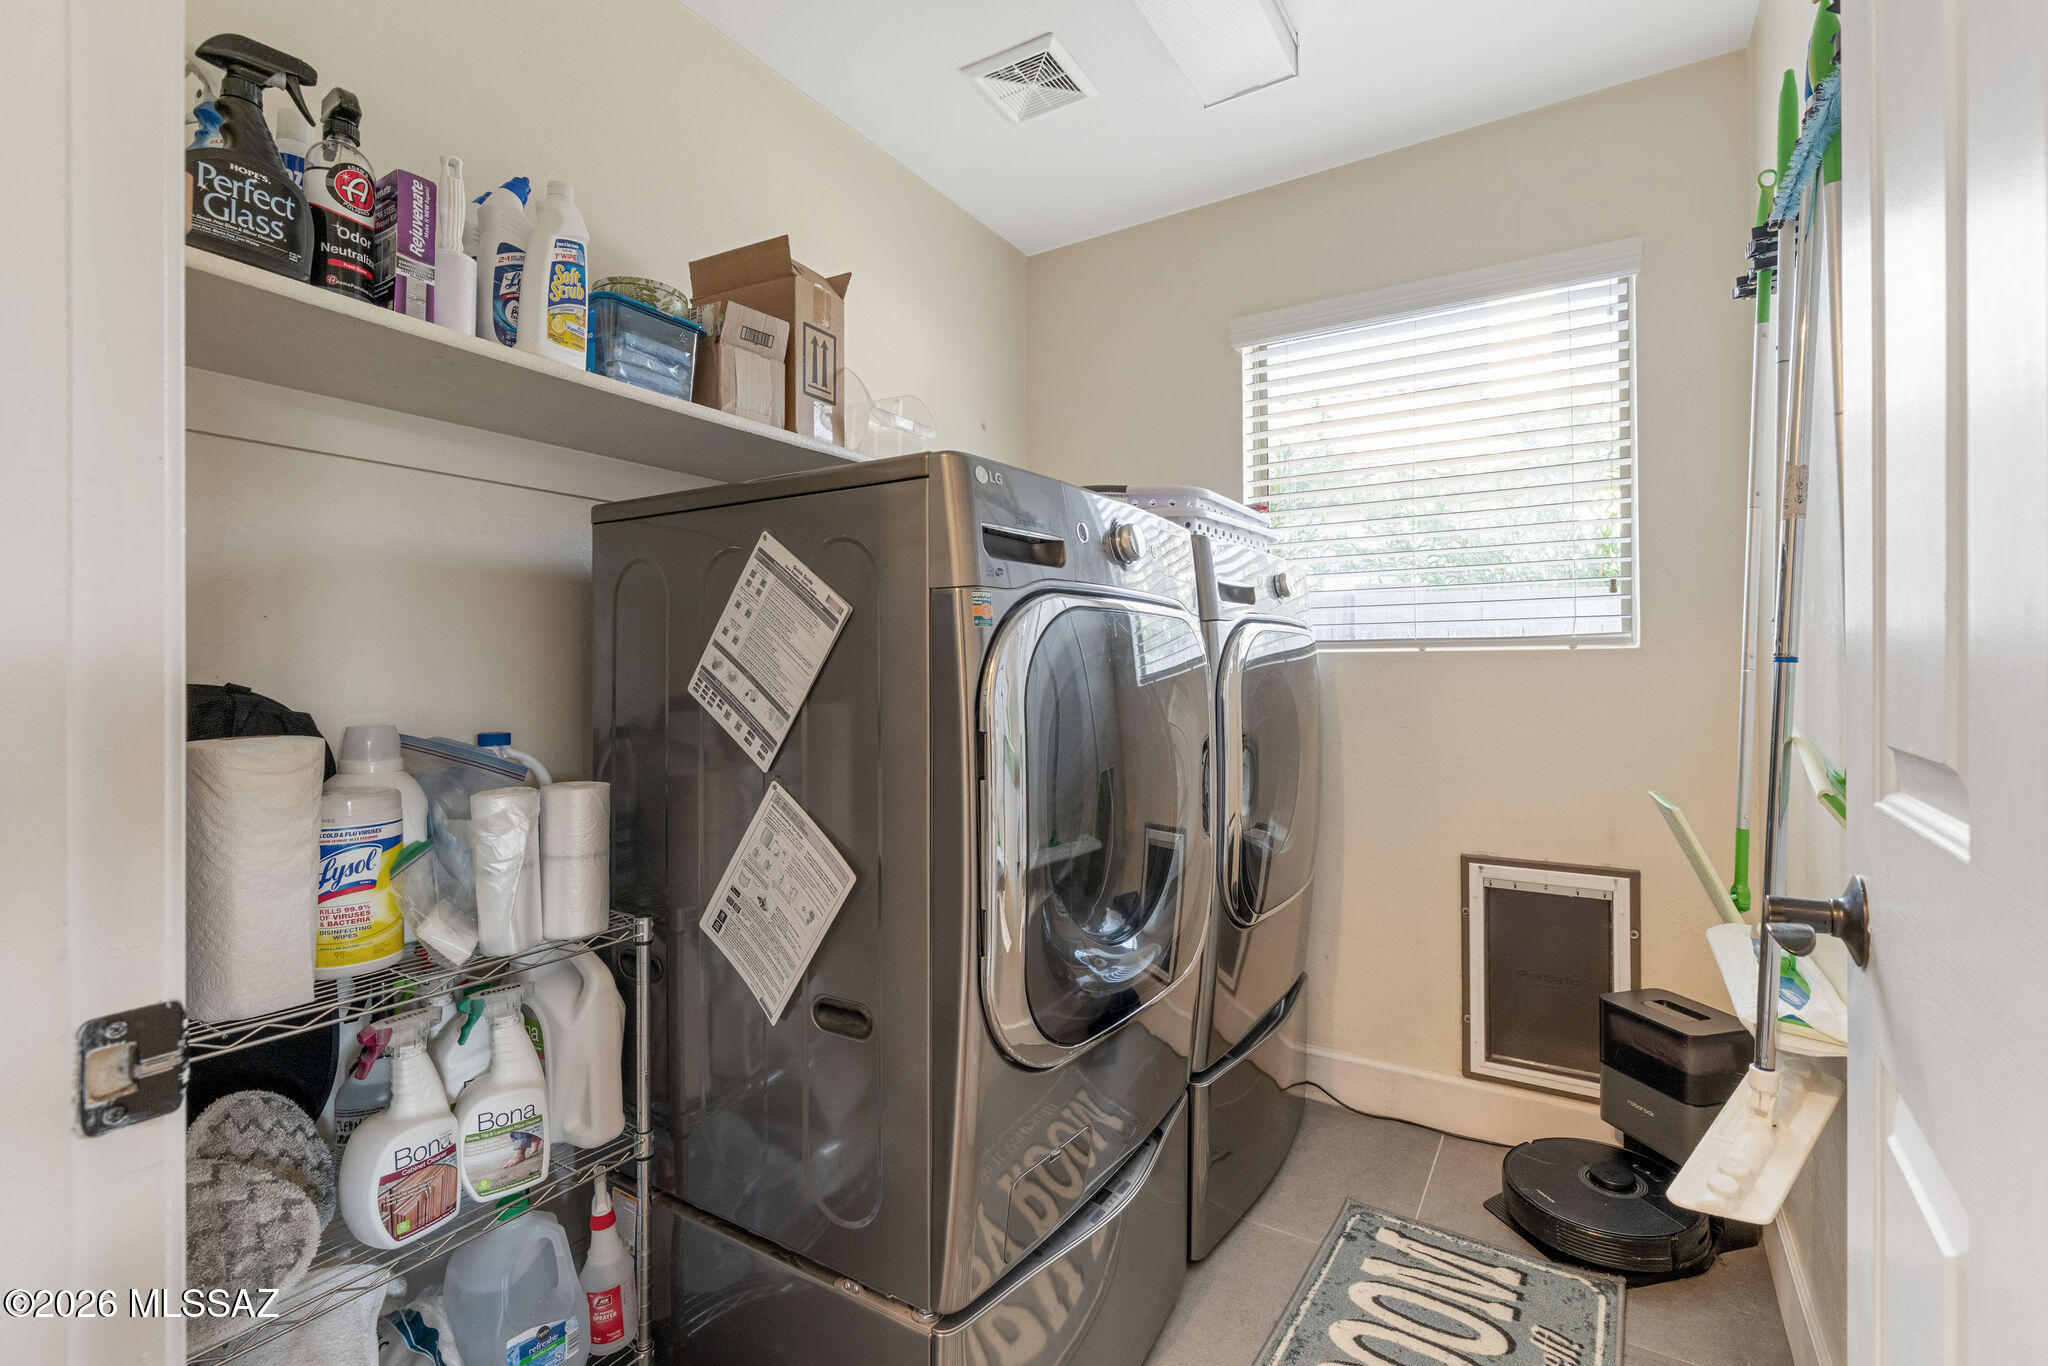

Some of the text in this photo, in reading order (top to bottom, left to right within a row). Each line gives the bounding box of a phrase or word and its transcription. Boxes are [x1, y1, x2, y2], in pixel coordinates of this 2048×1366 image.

[229, 163, 268, 183] HOPE'S
[197, 161, 296, 220] Perfect
[203, 192, 284, 240] Glass
[409, 179, 426, 258] Rejuvenate
[337, 227, 372, 249] Odor
[553, 264, 581, 285] Soft
[550, 282, 585, 301] Scrub
[988, 470, 1003, 485] LG
[344, 830, 358, 838] FLU
[358, 828, 382, 836] VIRUSES
[318, 848, 377, 891] Lysol
[319, 903, 371, 915] KILLS 99.9%
[332, 910, 371, 920] VIRUSES
[319, 925, 372, 936] DISINFECTING
[327, 916, 371, 927] BACTERIA
[334, 951, 346, 959] 95
[480, 984, 521, 996] Bona
[478, 1104, 537, 1132] Bona
[1627, 1100, 1655, 1118] roborock
[401, 1150, 448, 1176] Cabinet Cleaner
[1317, 1227, 1527, 1366] OOM
[592, 1311, 617, 1321] SPRAYER
